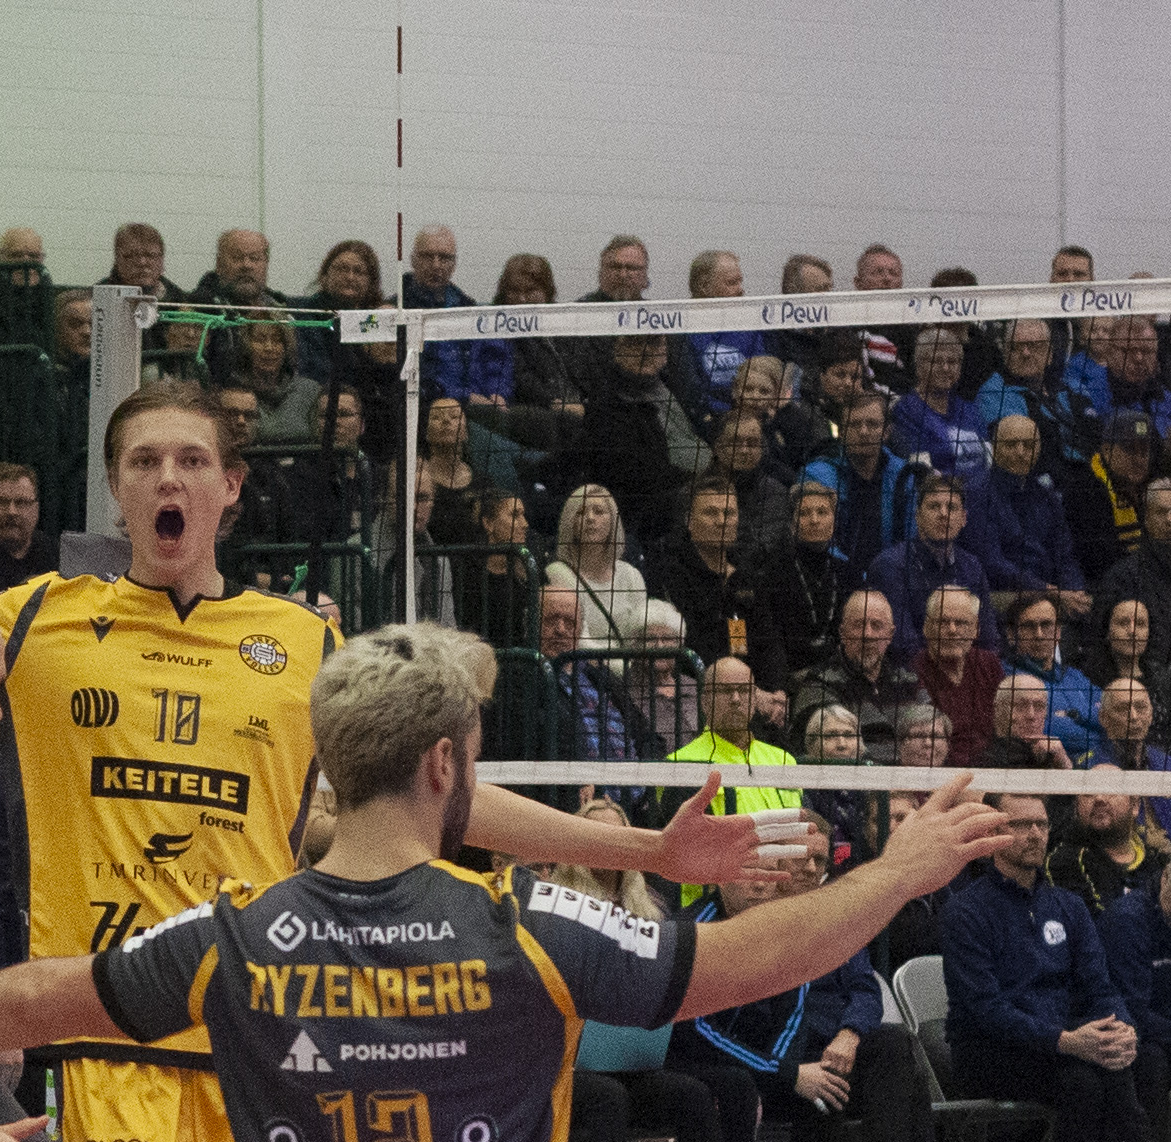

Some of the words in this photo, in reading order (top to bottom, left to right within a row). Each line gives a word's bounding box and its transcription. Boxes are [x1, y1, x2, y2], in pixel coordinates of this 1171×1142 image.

[1081, 288, 1132, 311] Pelvi
[493, 312, 539, 334] Pelvi
[636, 308, 682, 330] Pelvi
[781, 301, 829, 324] Pelvi
[166, 653, 214, 668] WULFF
[151, 687, 202, 746] 10
[102, 765, 240, 804] KEITELE
[198, 811, 246, 834] forest
[91, 861, 216, 890] TMRINVE
[339, 1040, 468, 1062] POHJONEN
